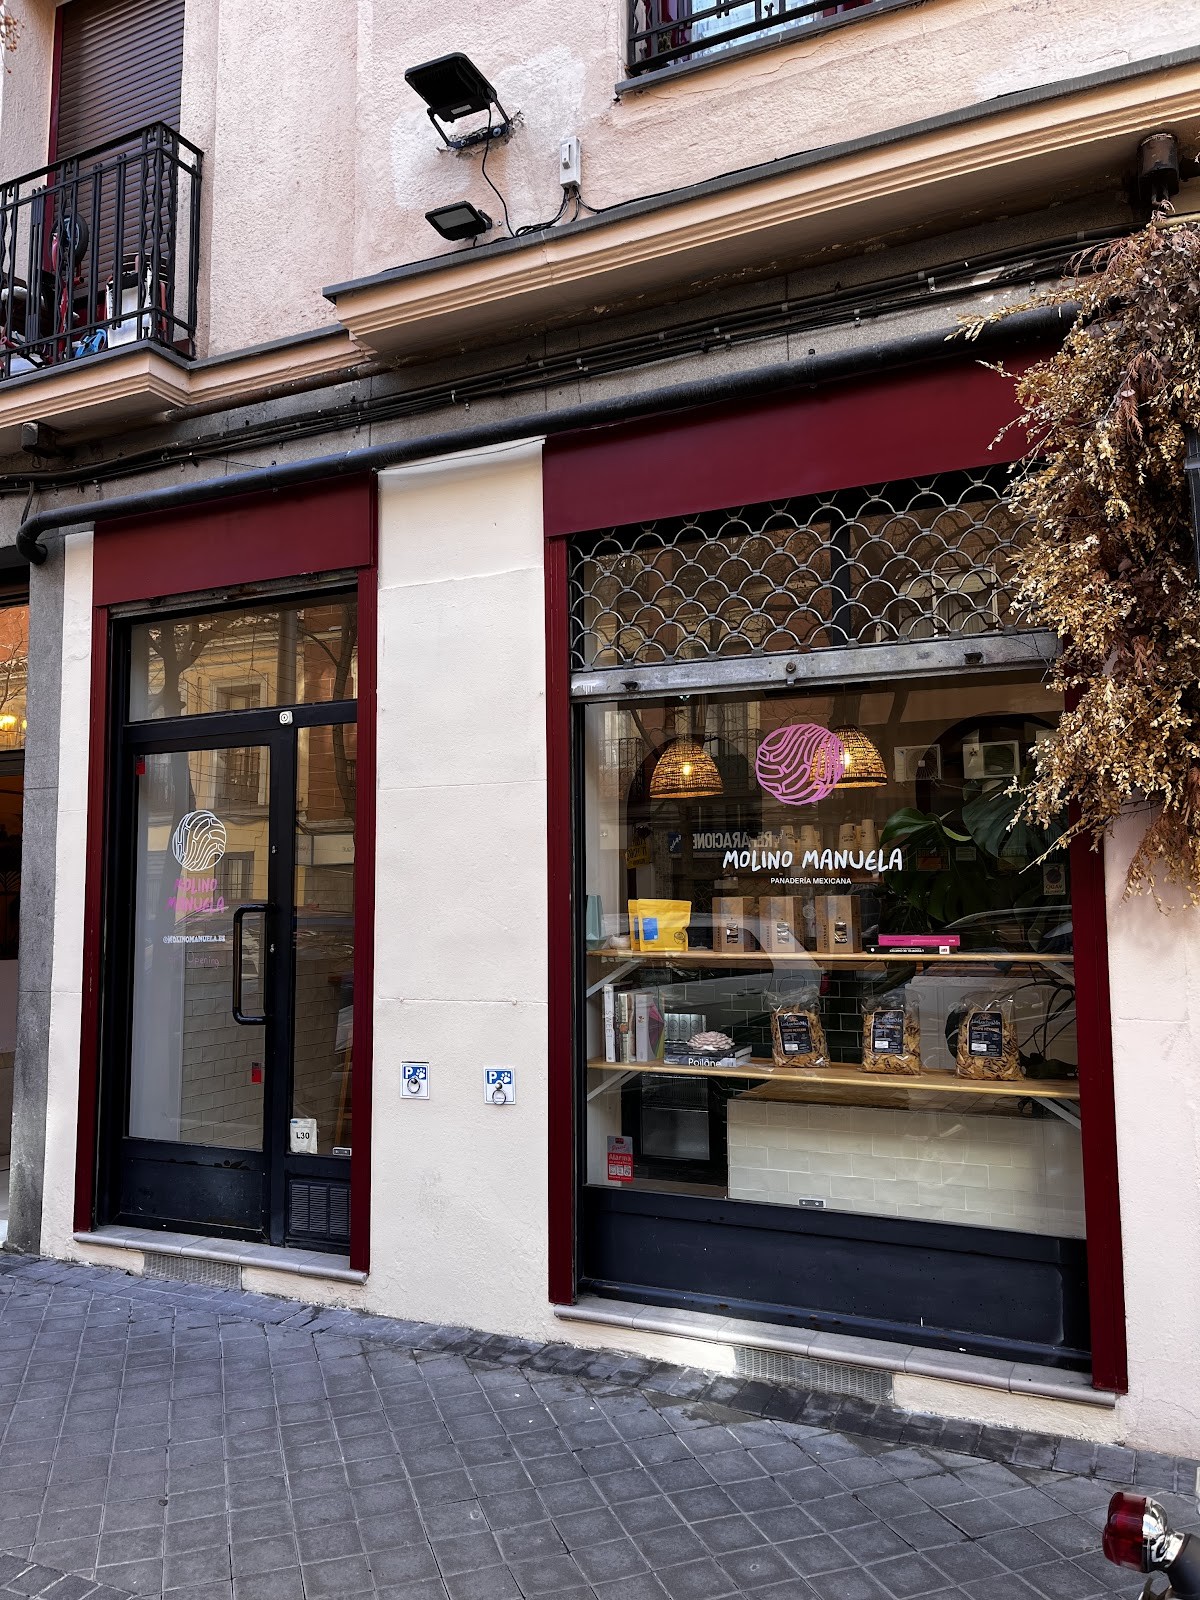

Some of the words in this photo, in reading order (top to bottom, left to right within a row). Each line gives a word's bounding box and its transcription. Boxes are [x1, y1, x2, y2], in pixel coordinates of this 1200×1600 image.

[722, 849, 793, 872] MOLINO
[802, 848, 903, 872] MANUELA
[173, 877, 218, 894] MOLINO
[770, 876, 812, 885] PANADERÍA
[813, 877, 852, 885] MEXICANA
[605, 1010, 613, 1039] SWEET
[688, 1057, 721, 1068] Poilâne
[405, 1066, 414, 1079] P
[488, 1071, 498, 1084] P
[296, 1131, 310, 1140] L30
